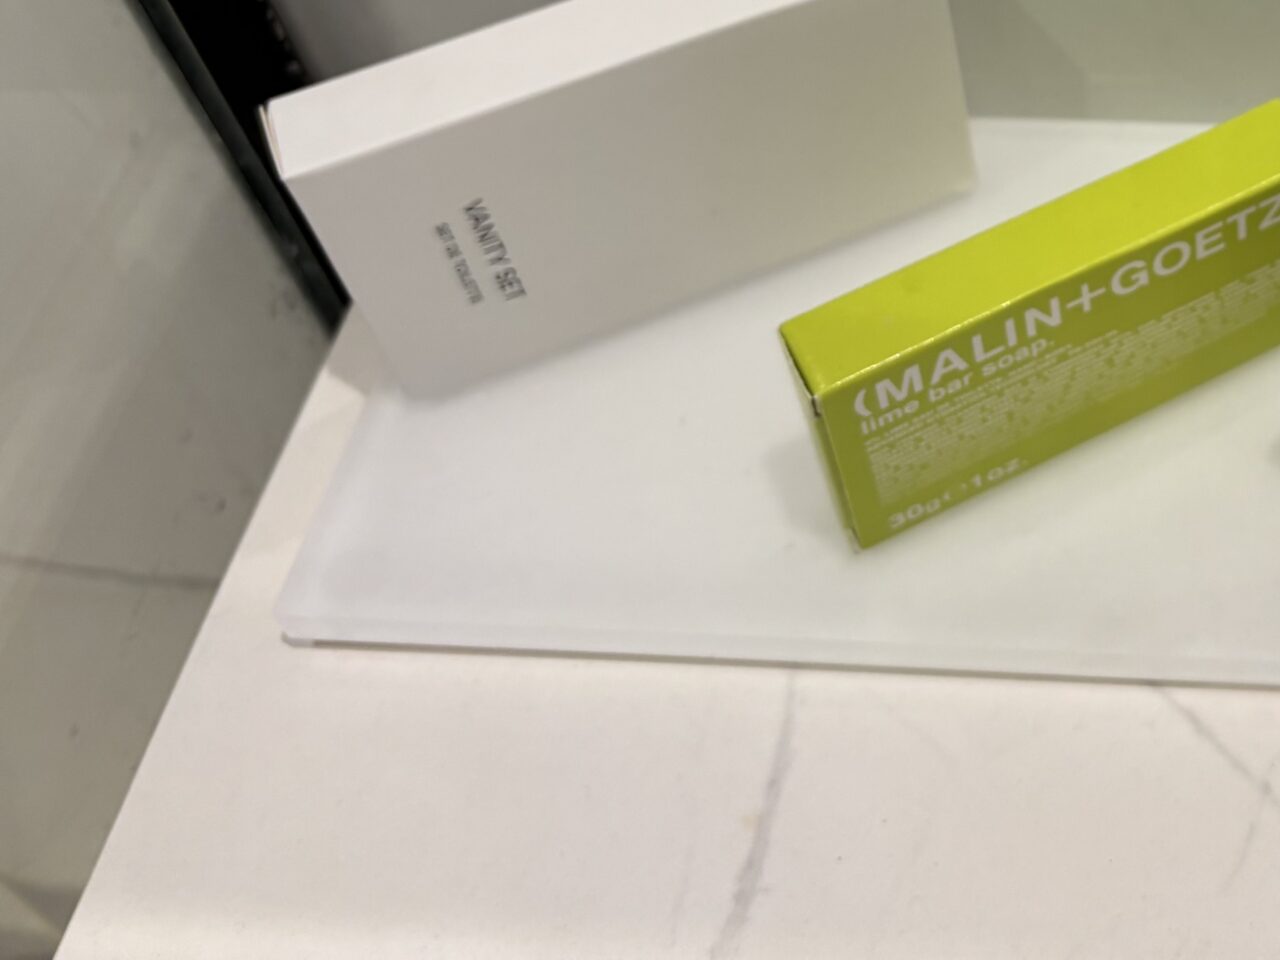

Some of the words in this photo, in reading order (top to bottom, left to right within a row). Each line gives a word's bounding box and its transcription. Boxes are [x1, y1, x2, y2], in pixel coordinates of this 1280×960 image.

[464, 197, 512, 266] VANITY
[494, 267, 527, 301] SET
[861, 400, 920, 435] lime
[928, 371, 973, 403] bar
